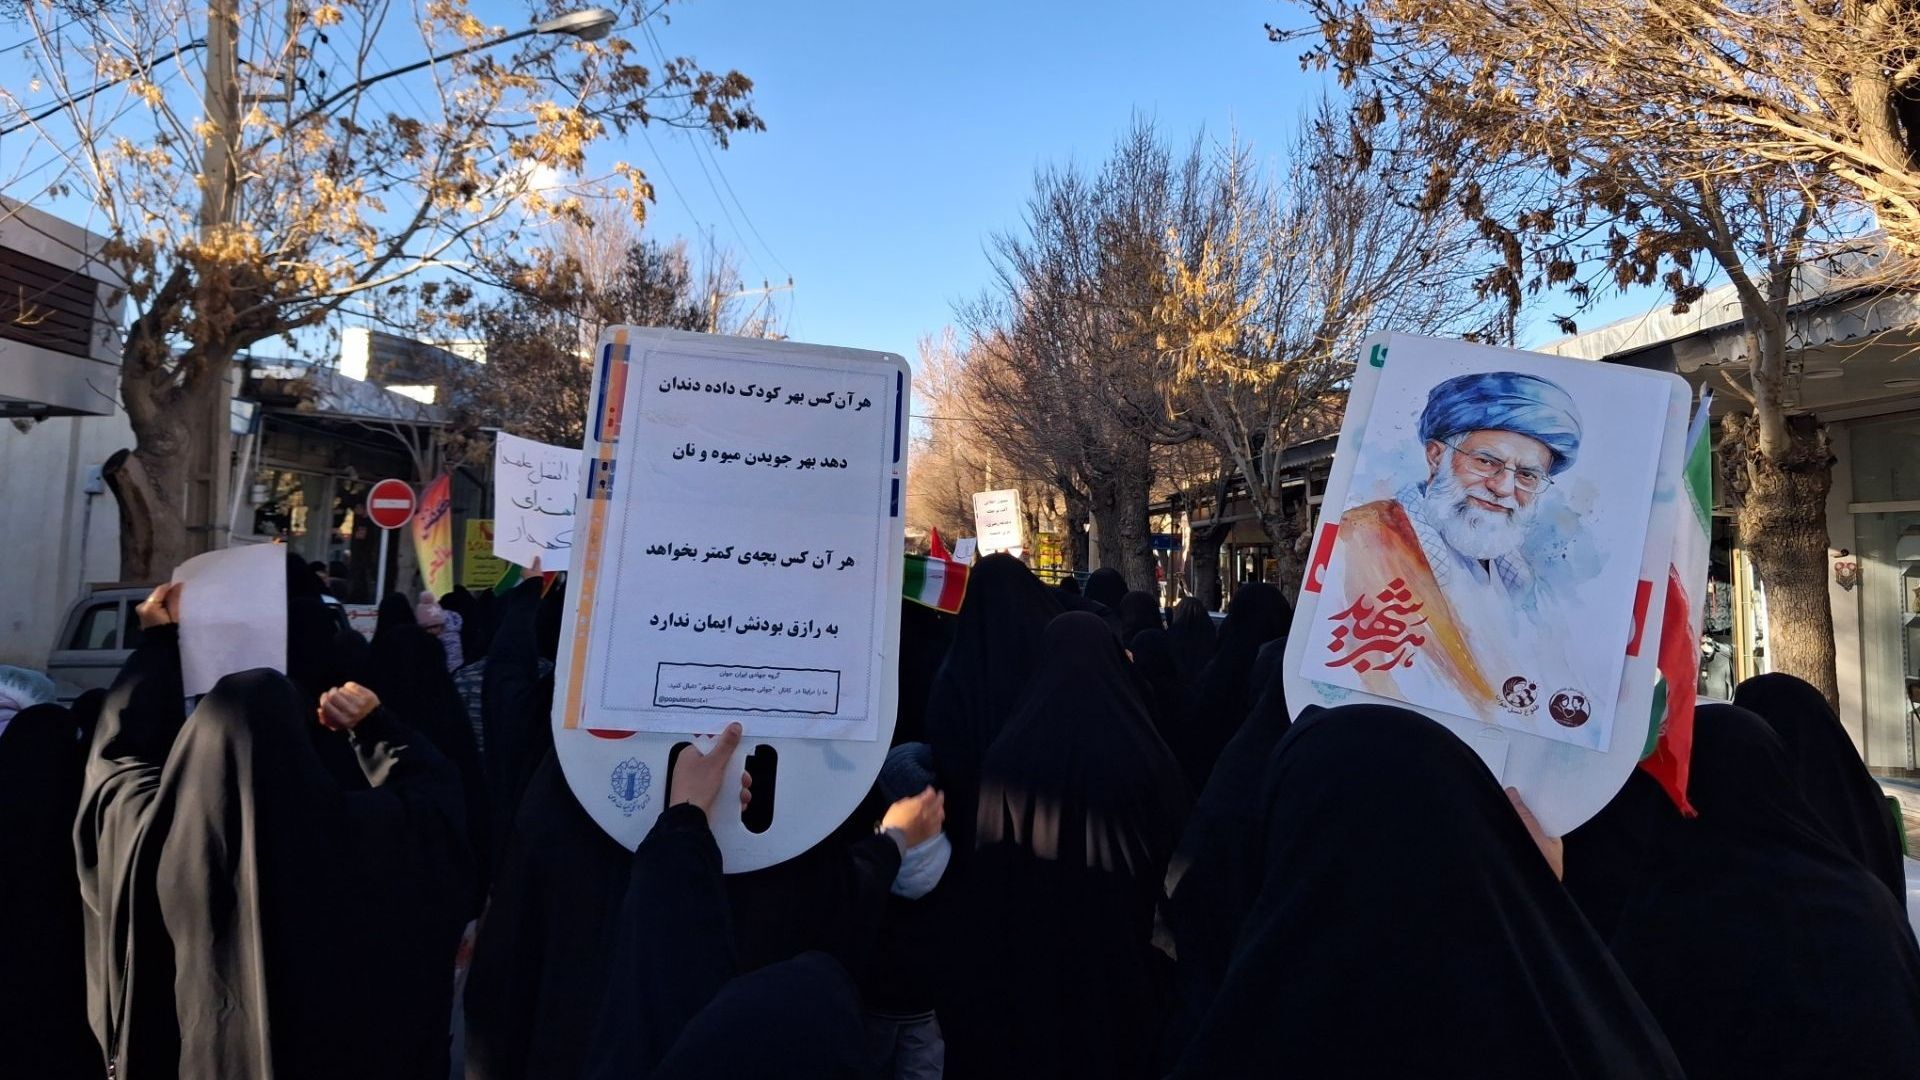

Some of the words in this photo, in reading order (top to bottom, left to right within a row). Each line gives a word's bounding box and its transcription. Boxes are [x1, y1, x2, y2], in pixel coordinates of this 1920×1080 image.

[658, 376, 701, 393] دندان
[705, 381, 736, 395] داده
[739, 384, 782, 403] کودک
[784, 392, 804, 406] بهر
[672, 443, 696, 460] نان
[699, 450, 707, 462] و
[711, 449, 741, 464] میوه
[744, 452, 793, 468] جویدن
[796, 456, 816, 470] بهر
[820, 456, 848, 469] دهد
[646, 541, 698, 561] بخواهد
[700, 546, 735, 563] کمتر
[780, 550, 809, 567] کس
[812, 550, 834, 569] آن
[836, 555, 856, 570] هر
[649, 611, 690, 631] ندارد
[693, 614, 732, 633] ایمان
[735, 615, 783, 636] بودنش
[787, 619, 821, 638] رازق
[825, 623, 839, 639] به
